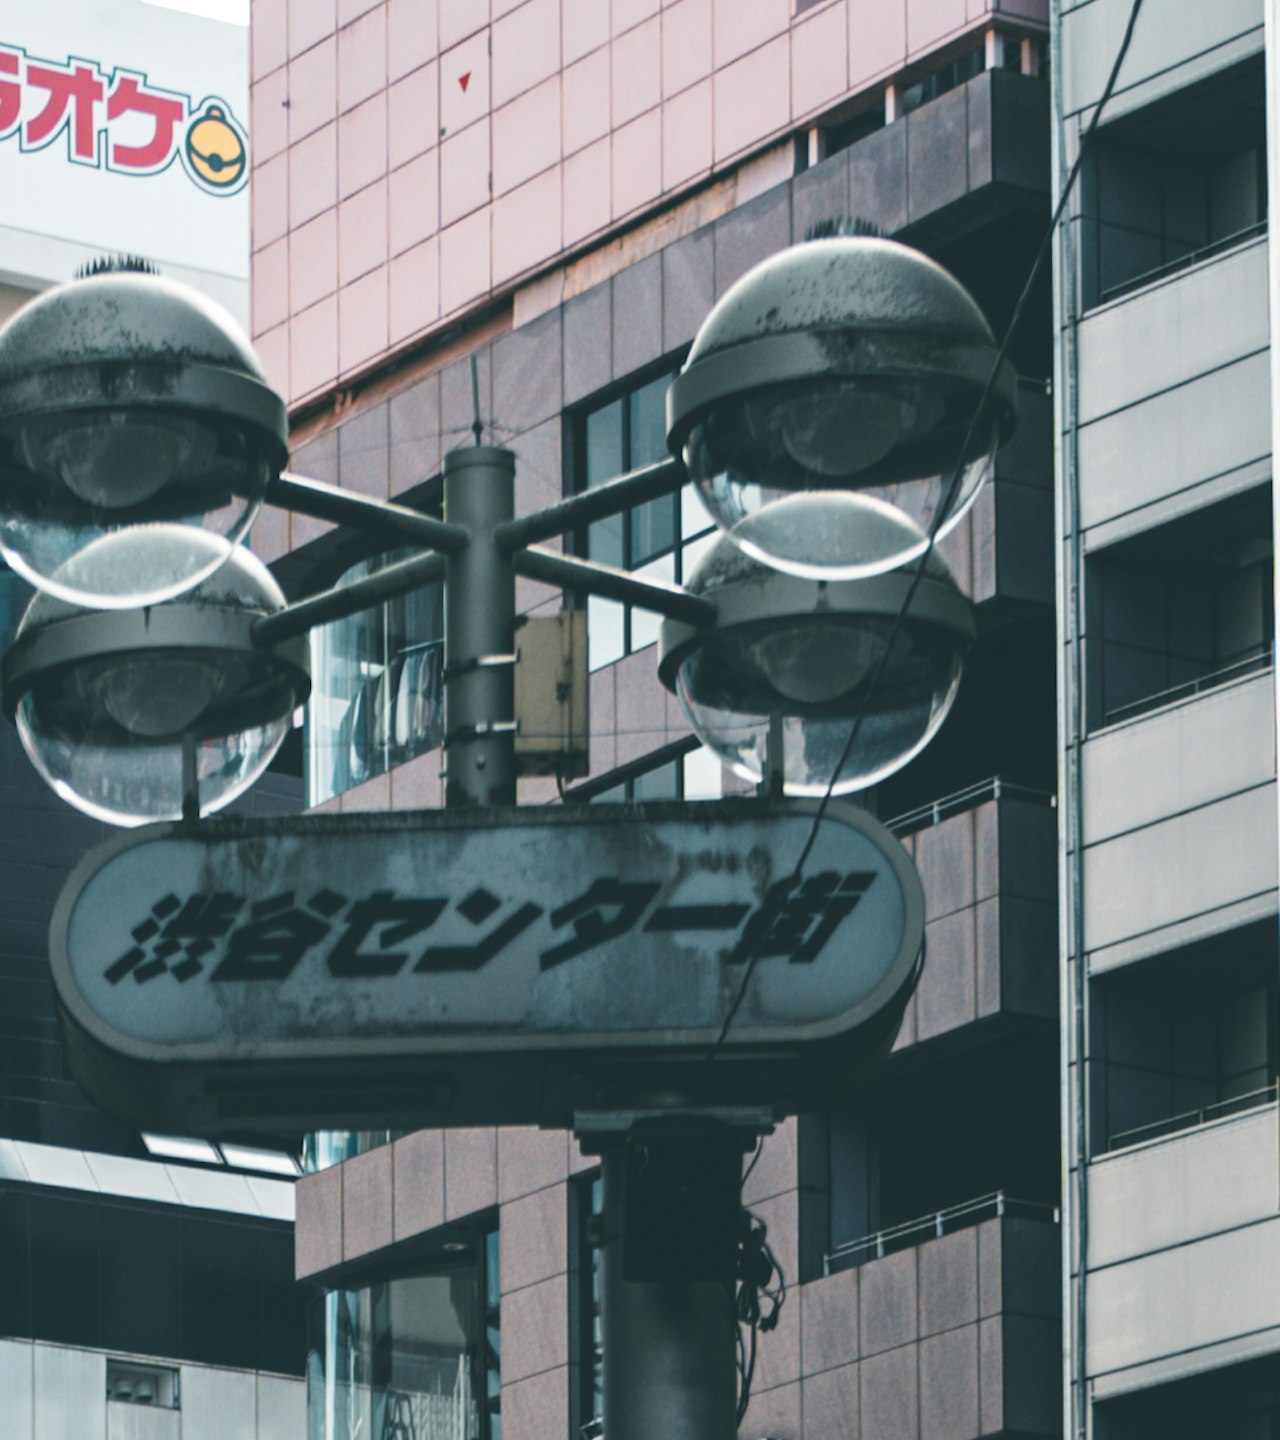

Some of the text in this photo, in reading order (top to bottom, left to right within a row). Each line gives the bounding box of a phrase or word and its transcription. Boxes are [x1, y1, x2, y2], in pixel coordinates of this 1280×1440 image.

[103, 869, 878, 986] 渋谷センター街
